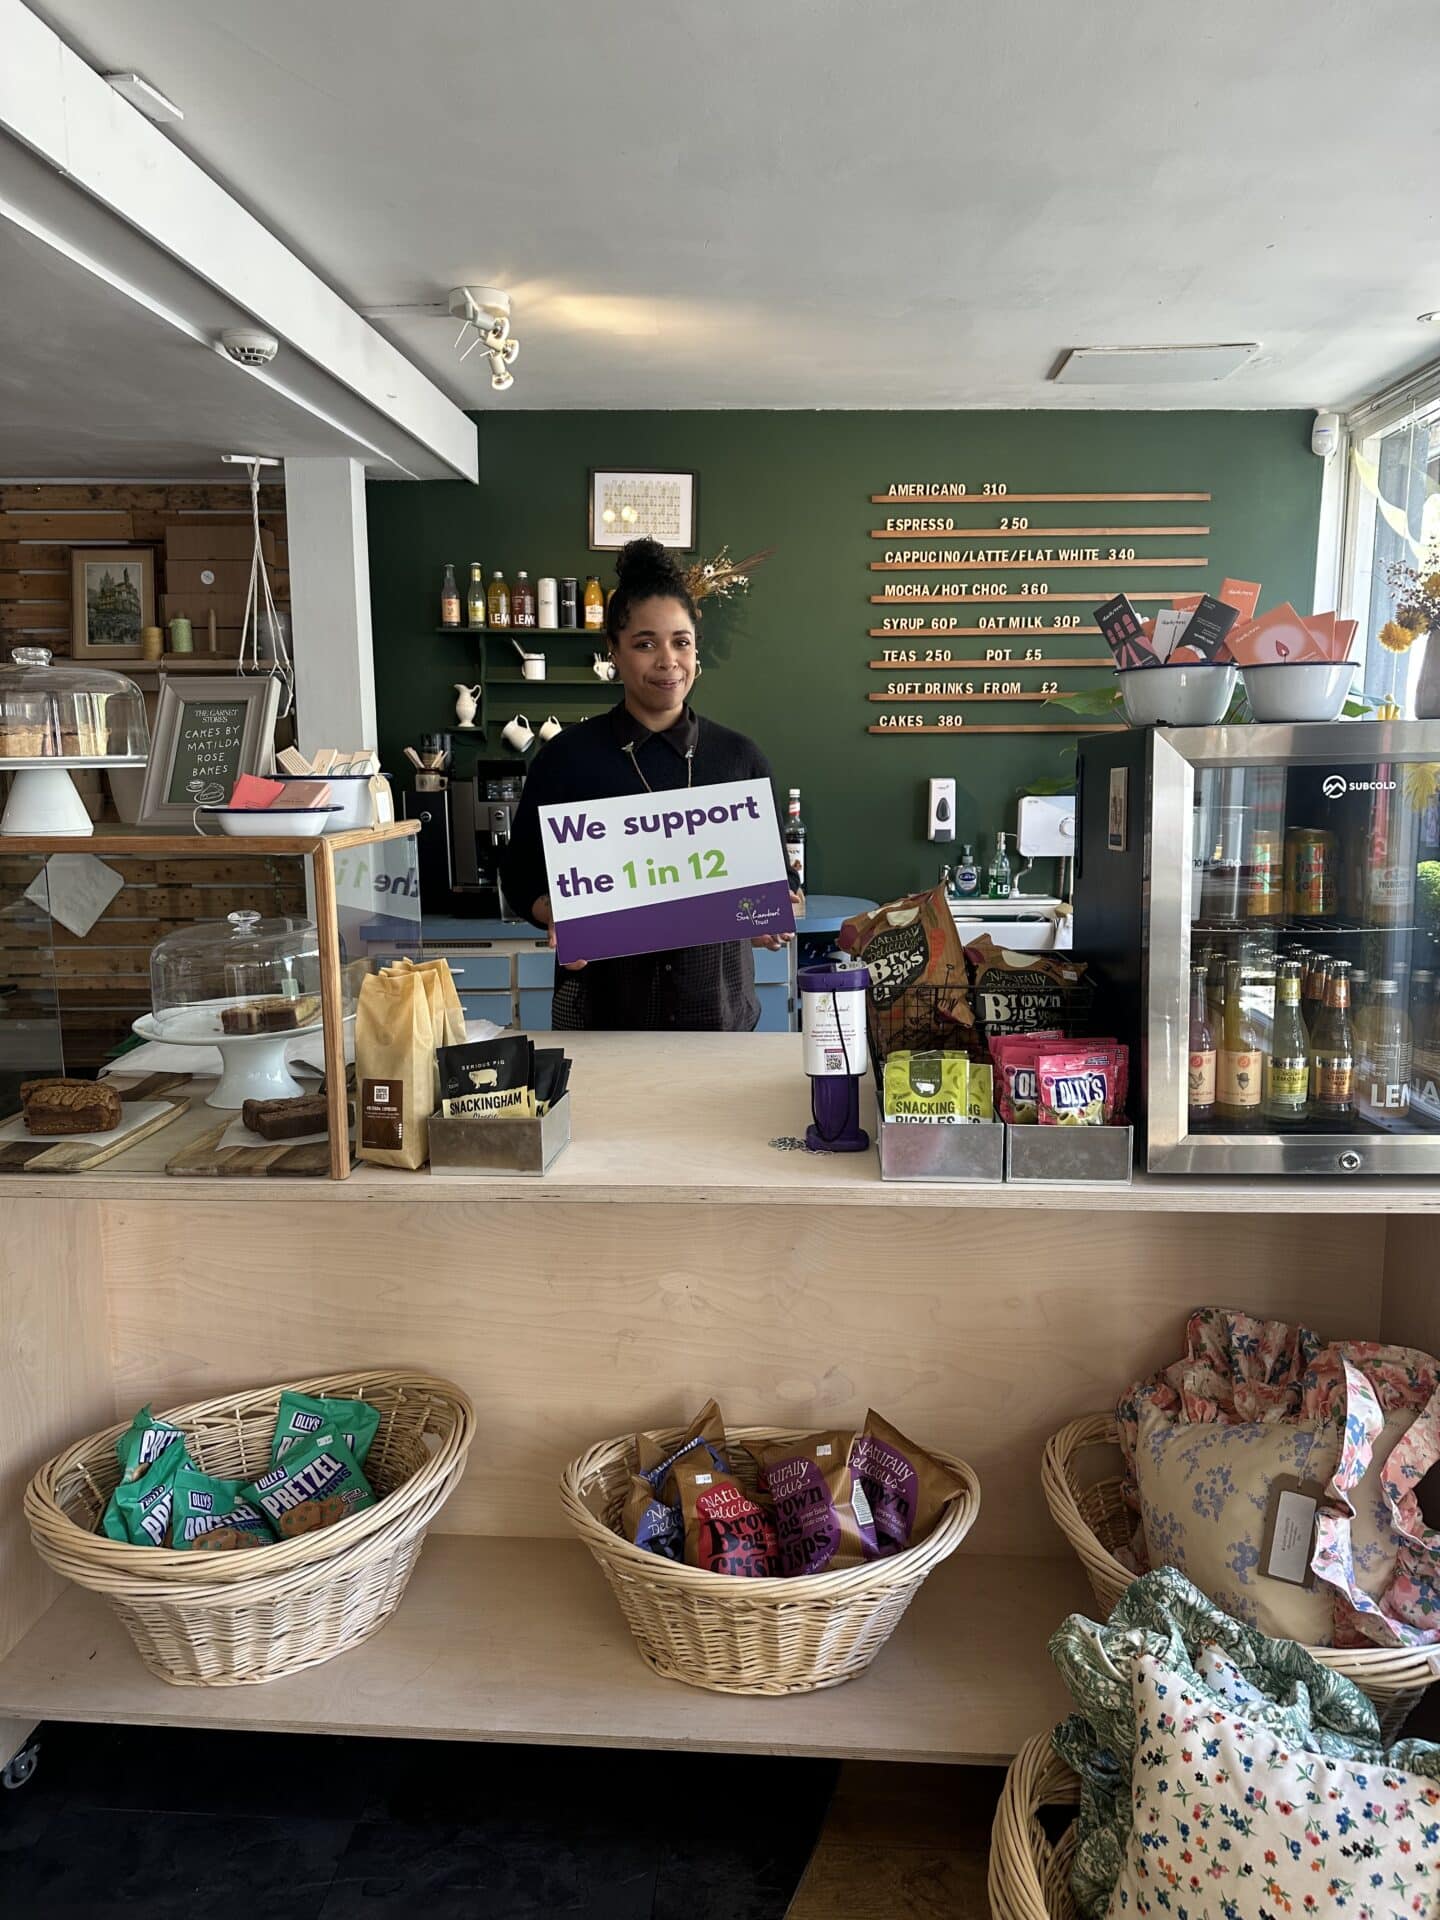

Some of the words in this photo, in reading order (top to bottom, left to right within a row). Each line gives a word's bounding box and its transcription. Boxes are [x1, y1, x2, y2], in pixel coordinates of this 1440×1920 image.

[888, 484, 966, 497] AMERICANO
[983, 484, 1007, 496] 310
[887, 519, 954, 531] ESPRESSO
[1058, 549, 1099, 561] WHITE
[1109, 549, 1135, 560] 340
[884, 584, 968, 597] MOCHA/HOT
[972, 584, 1008, 596] CHOC
[1020, 583, 1048, 596] 360
[883, 617, 925, 630] SYRUP
[931, 617, 958, 629] 60P
[979, 617, 1005, 629] OAT
[1009, 616, 1042, 628] MILK
[1053, 615, 1080, 628] 30P
[883, 650, 917, 662] TEAS
[925, 650, 951, 662] 250
[986, 649, 1012, 661] POT
[1025, 649, 1042, 661] £5
[887, 683, 921, 695] SOFT
[925, 683, 973, 695] DRINKS
[984, 682, 1021, 694] FROM
[1041, 682, 1058, 694] £2
[879, 716, 923, 728] CAKES
[937, 715, 963, 727] 380
[185, 727, 221, 738] CAKES
[225, 725, 240, 735] BY
[187, 738, 240, 752] MATILDA
[197, 752, 224, 764] ROSE
[192, 765, 228, 776] BAKES
[1349, 782, 1397, 791] SUBCOLD
[548, 814, 607, 844] We
[624, 796, 760, 838] support
[557, 867, 614, 897] the
[622, 861, 637, 888] 1
[646, 858, 680, 886] in
[688, 850, 728, 880] 12
[450, 1091, 522, 1115] SNACKINGHAM
[895, 1101, 955, 1114] SNACKING
[295, 1414, 320, 1431] OLLY'S
[261, 1453, 343, 1519] PRETZEL
[192, 1492, 211, 1509] OLLY'S
